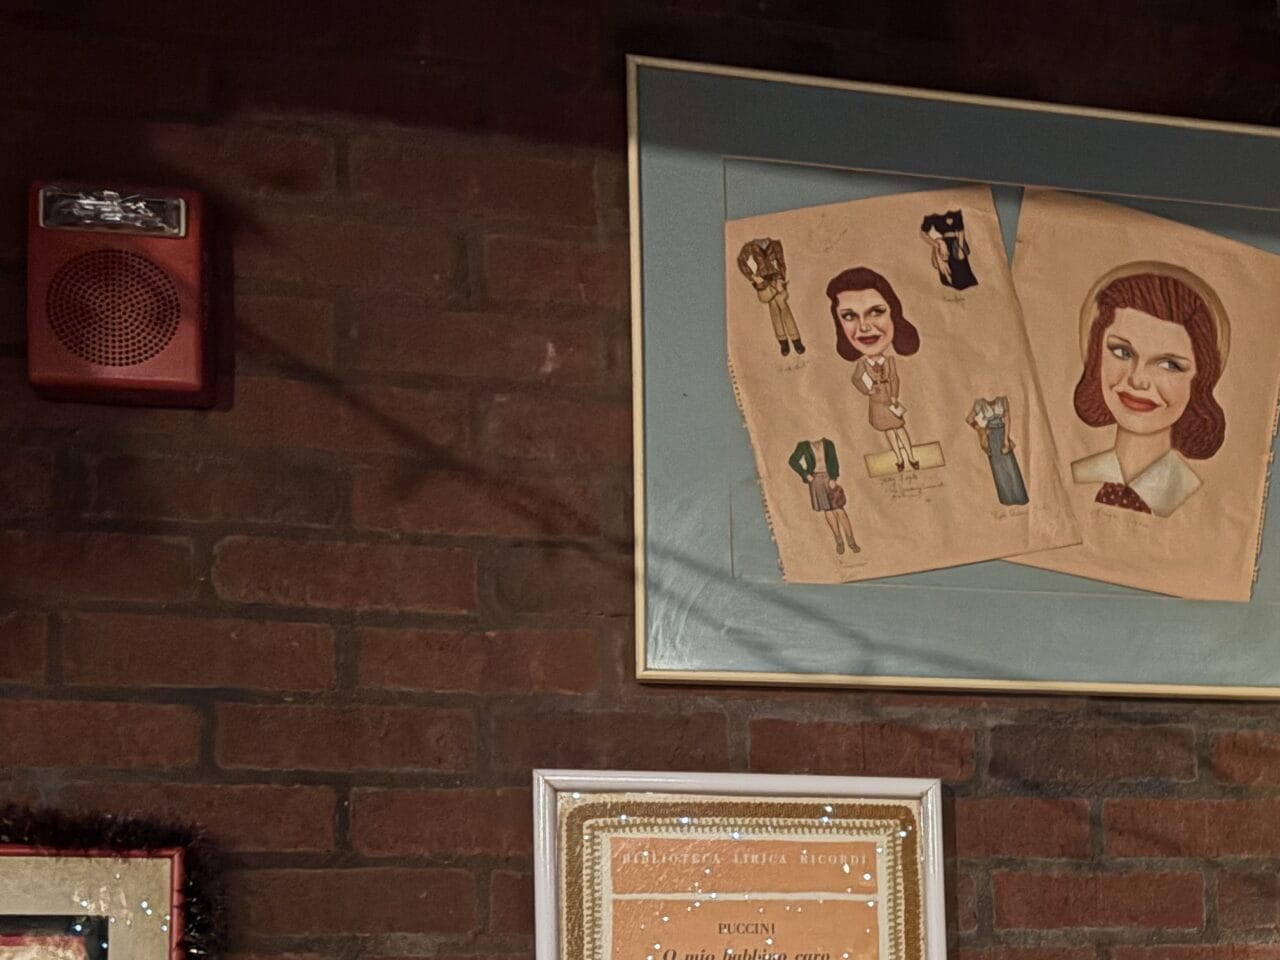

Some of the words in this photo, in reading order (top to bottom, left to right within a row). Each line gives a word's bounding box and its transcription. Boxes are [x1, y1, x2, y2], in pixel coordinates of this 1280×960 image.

[732, 853, 788, 866] LIRICA
[800, 853, 867, 866] RICORDI
[718, 922, 776, 935] PUCCINI
